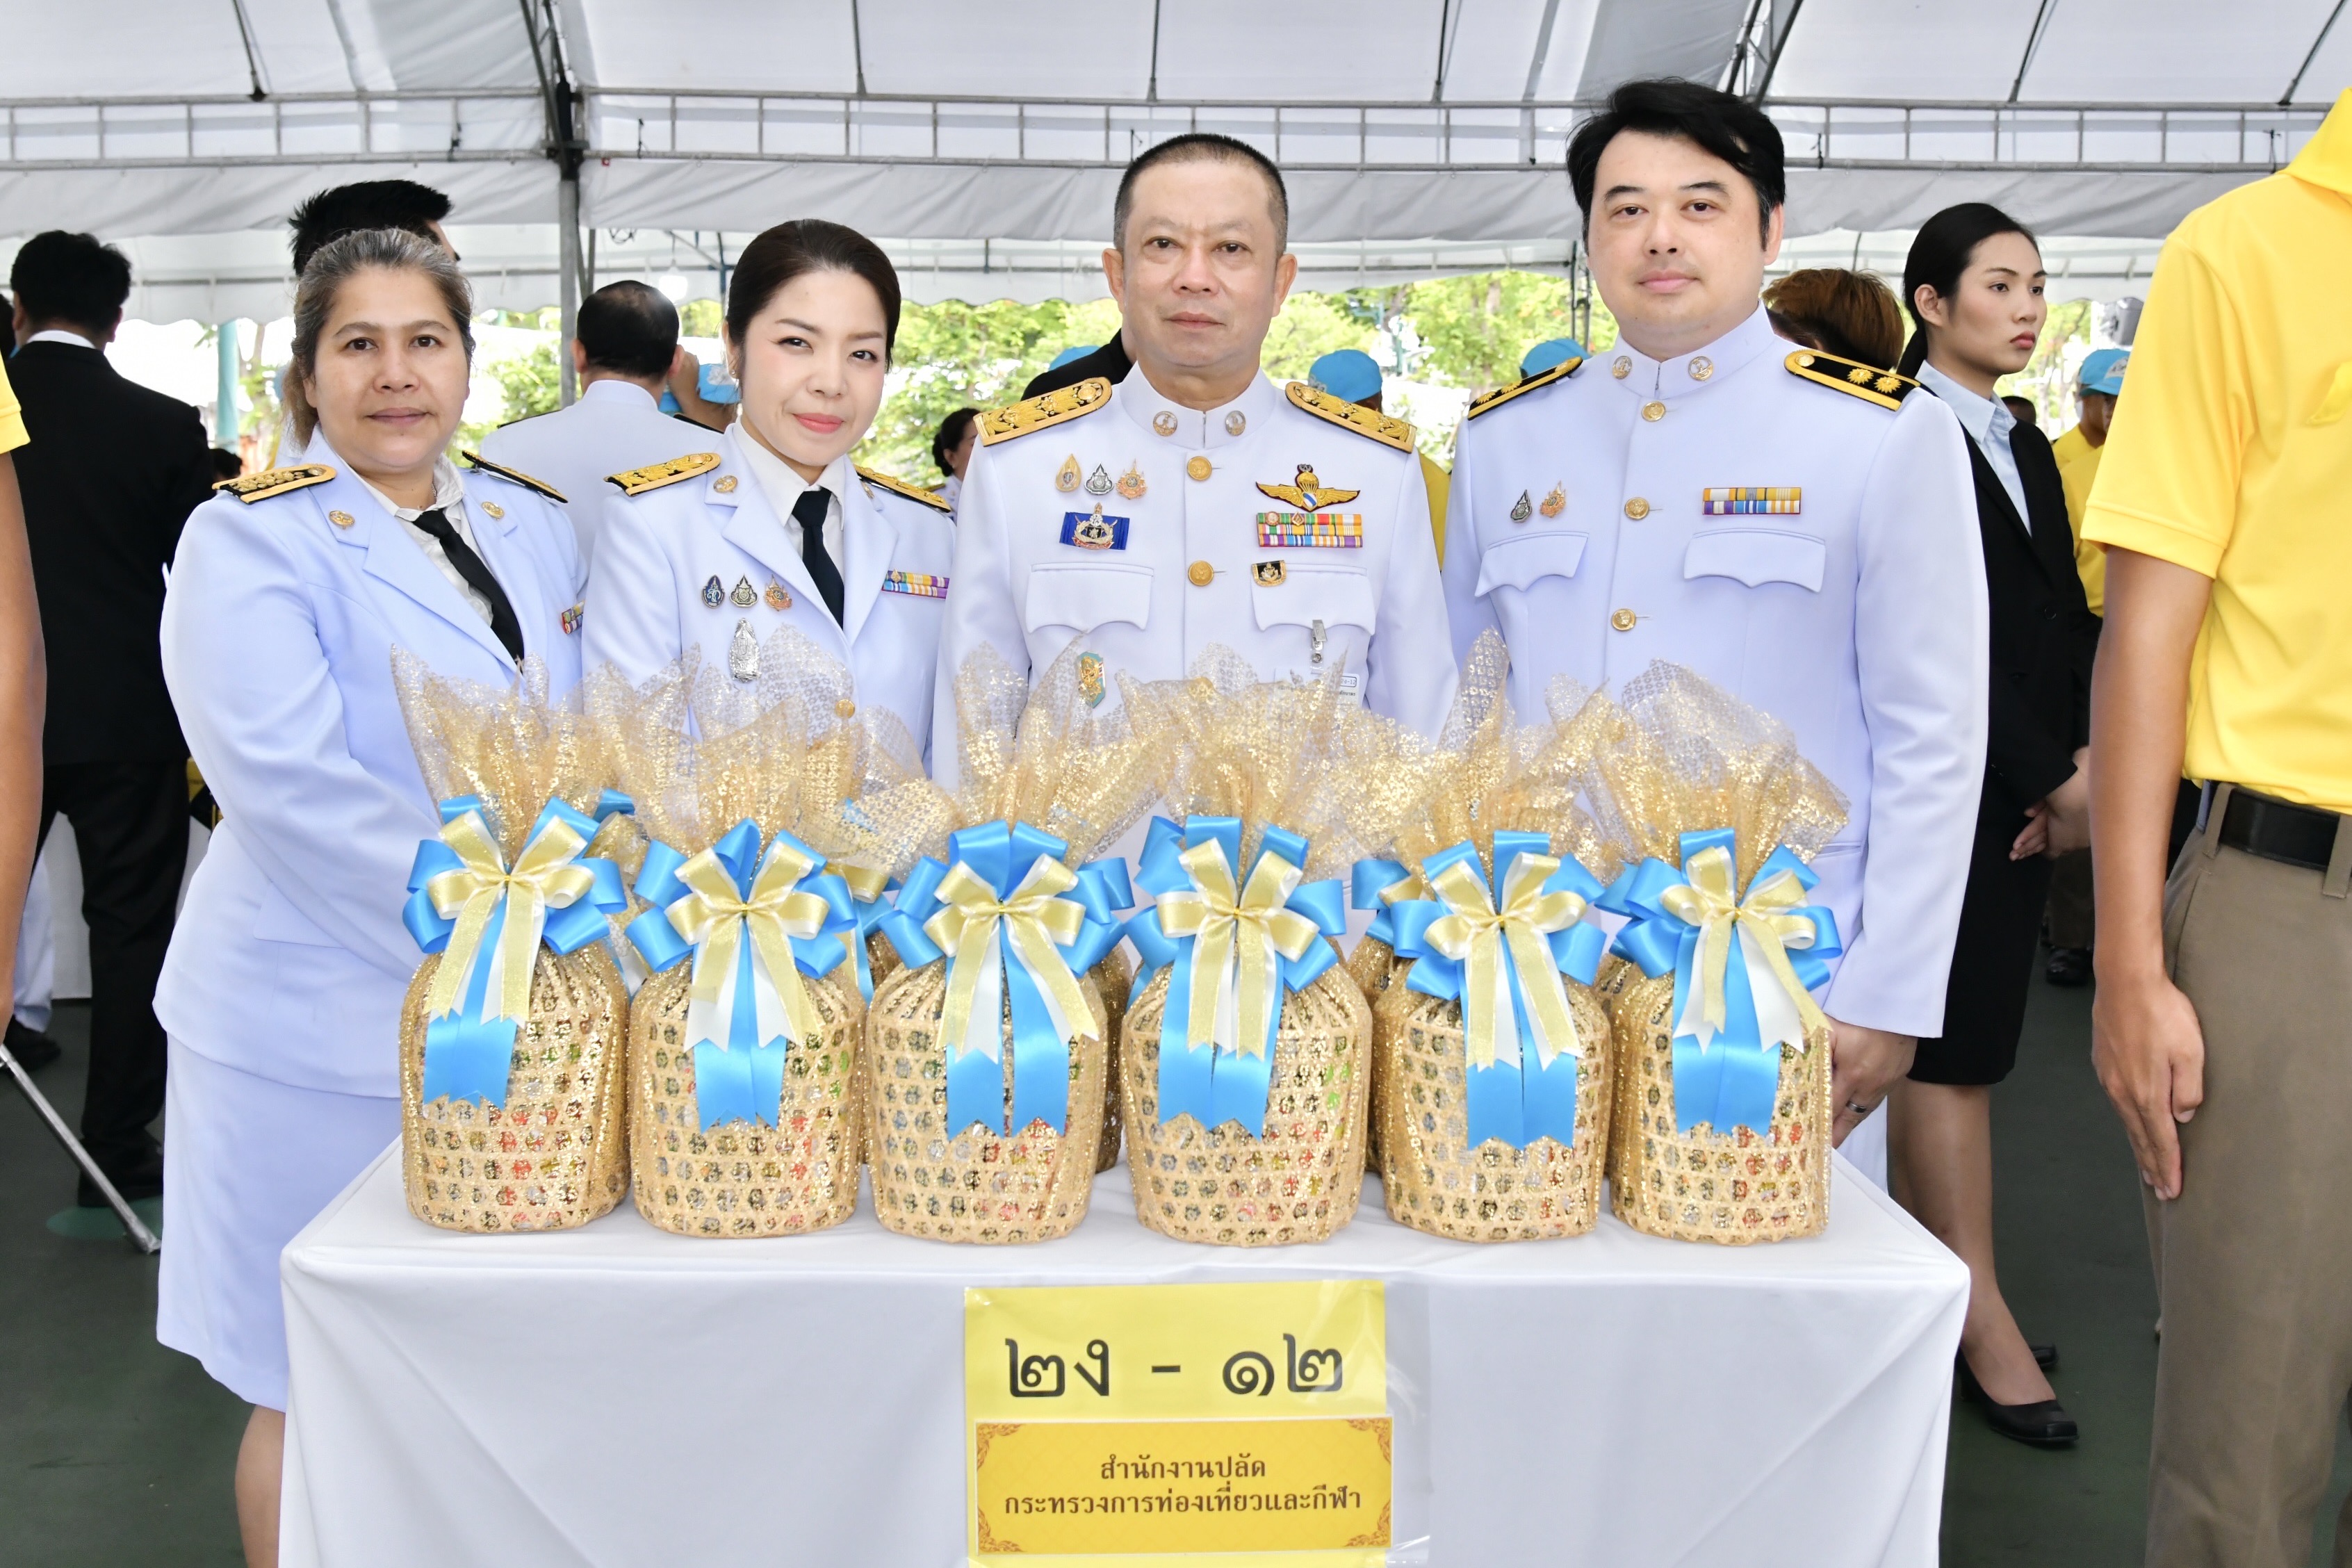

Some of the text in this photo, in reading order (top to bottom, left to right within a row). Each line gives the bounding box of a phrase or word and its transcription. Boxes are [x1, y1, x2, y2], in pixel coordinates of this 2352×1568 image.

[1005, 1333, 1342, 1398] ๒ง - ๑๒
[1101, 1453, 1266, 1480] สำนักงานปลัด
[1005, 1481, 1361, 1514] กระทรวงการท่องเที่ยวและกีฬา
